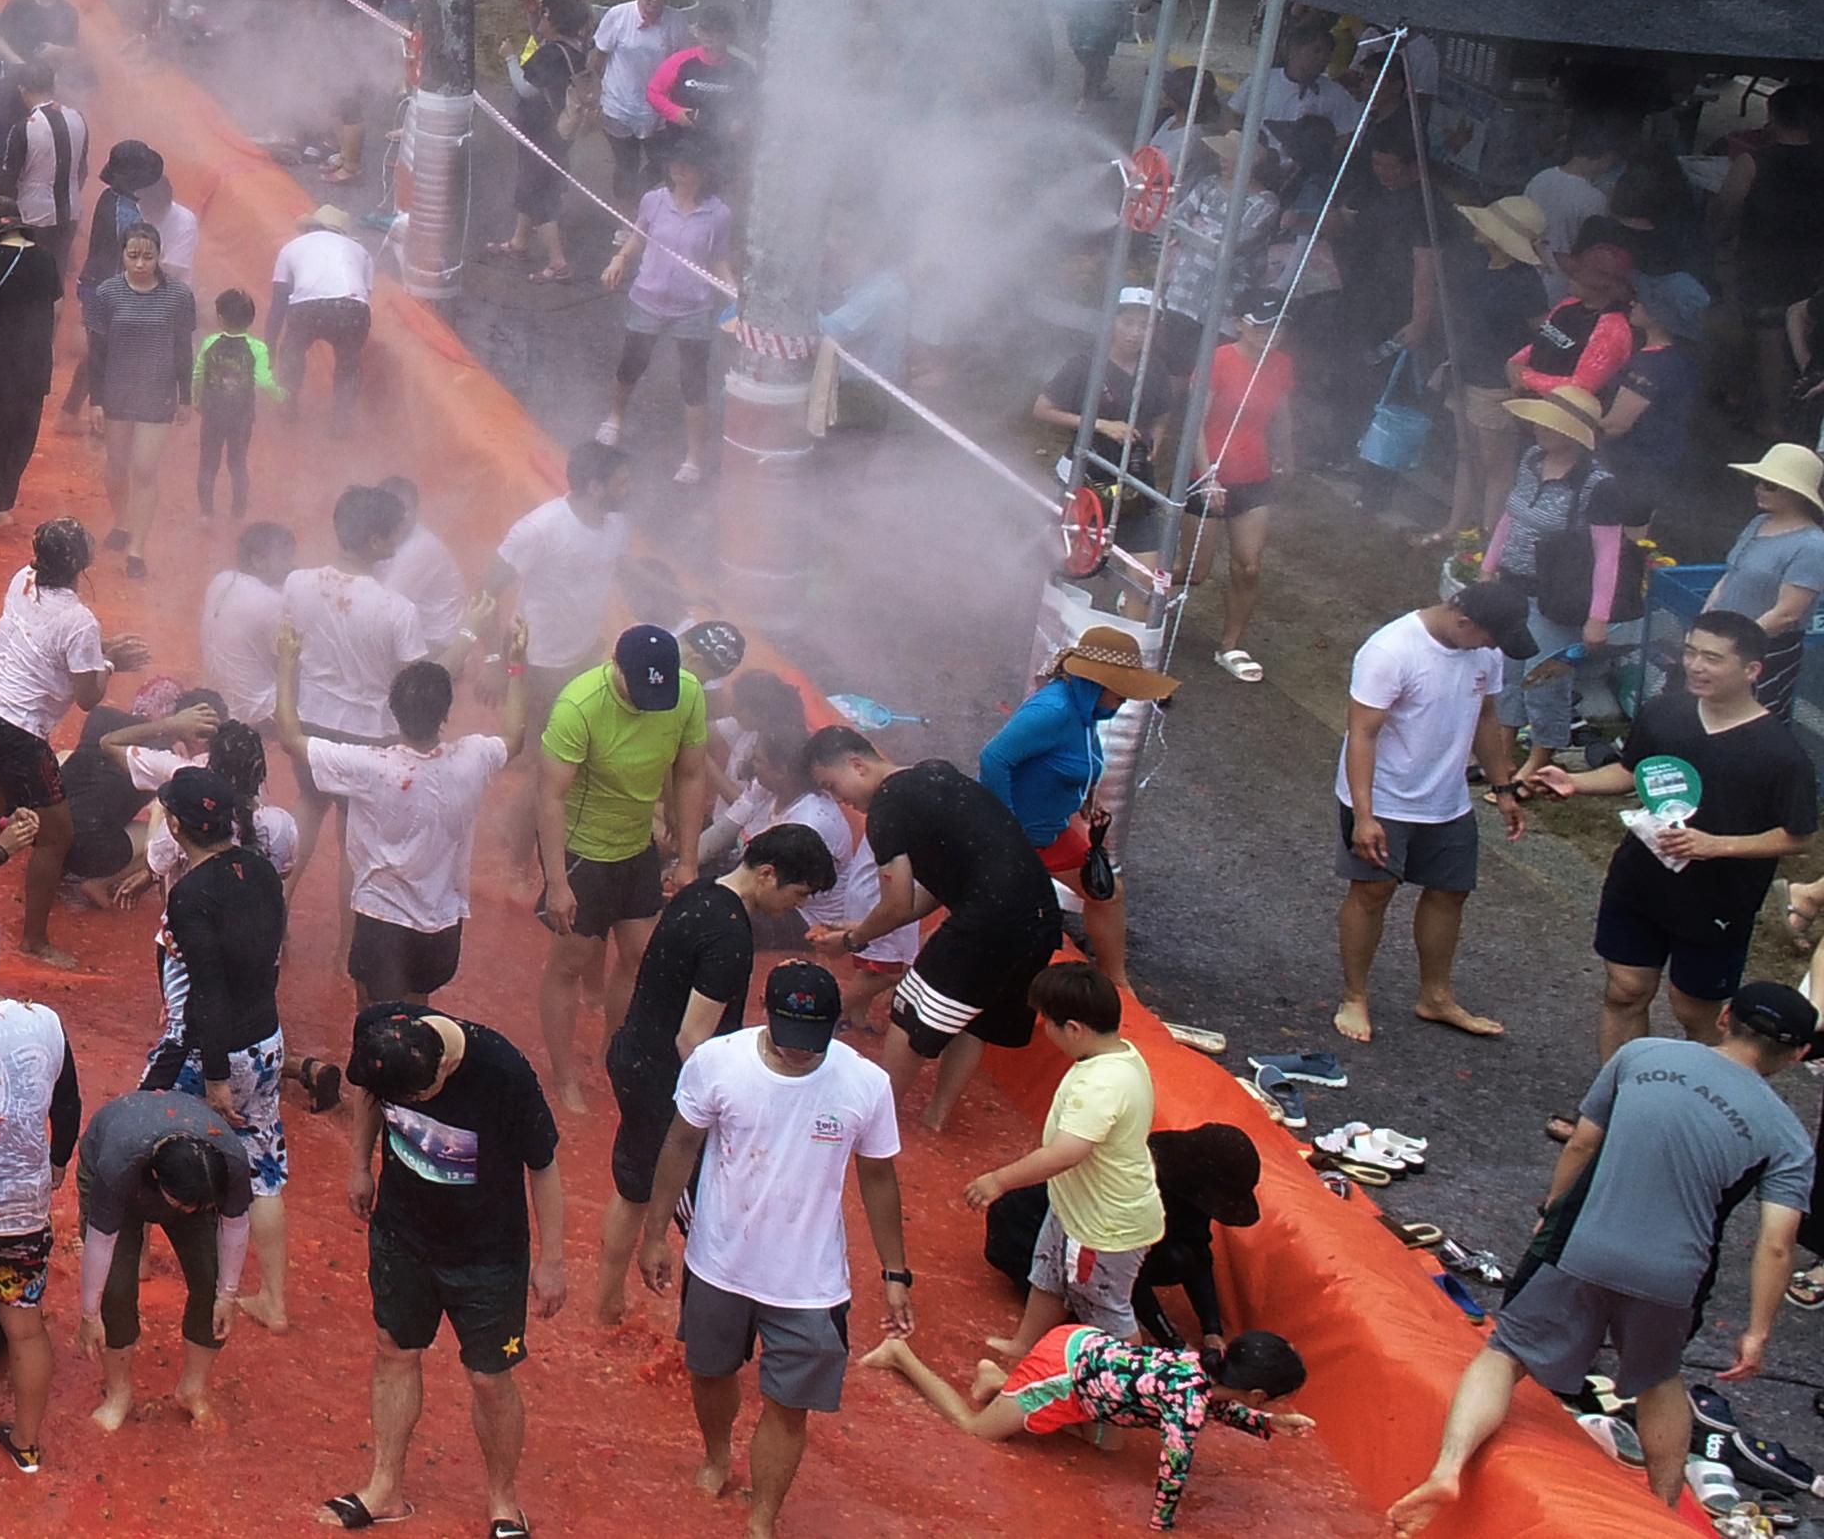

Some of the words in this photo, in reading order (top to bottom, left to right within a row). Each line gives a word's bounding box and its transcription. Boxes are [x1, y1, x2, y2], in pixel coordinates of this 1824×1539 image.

[648, 667, 664, 684] LA
[1636, 1069, 1687, 1086] ROK
[1692, 1083, 1753, 1143] ARMY
